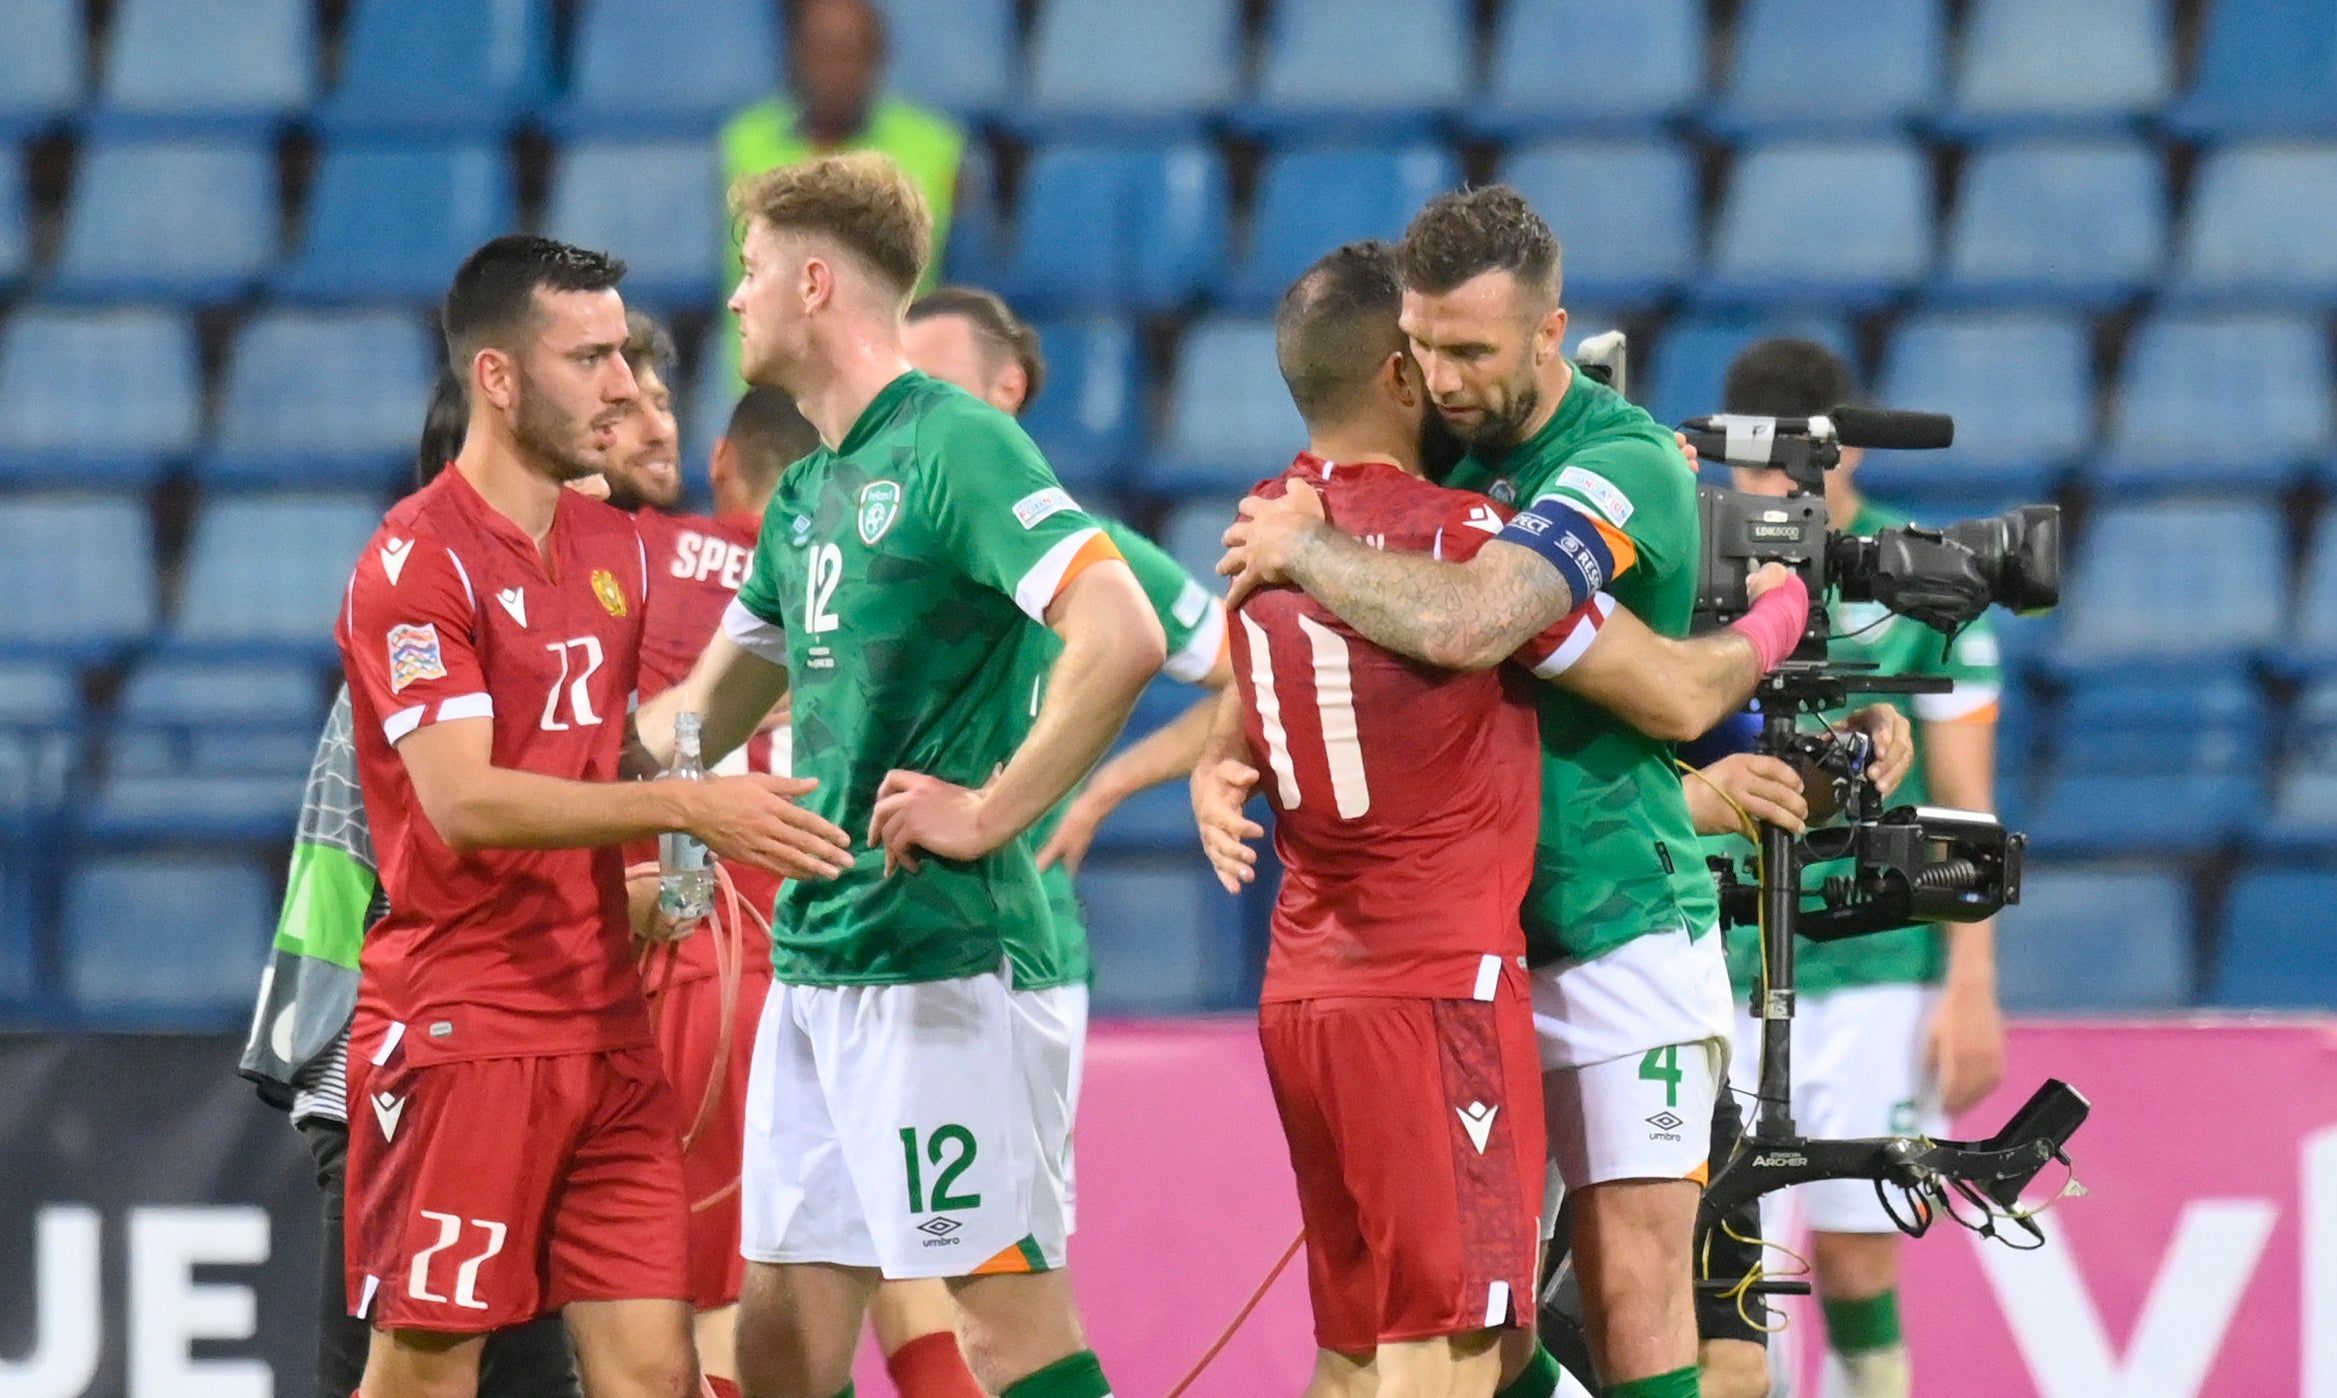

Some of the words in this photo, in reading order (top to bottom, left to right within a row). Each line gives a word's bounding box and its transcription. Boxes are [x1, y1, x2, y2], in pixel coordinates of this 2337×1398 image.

[805, 543, 842, 634] 12
[540, 635, 604, 731] 22
[1239, 608, 1370, 820] 11
[1638, 1044, 1682, 1107] 4
[899, 1123, 981, 1214] 12
[1649, 1132, 1682, 1142] umbro
[408, 1210, 508, 1310] 22
[922, 1236, 960, 1247] umbro
